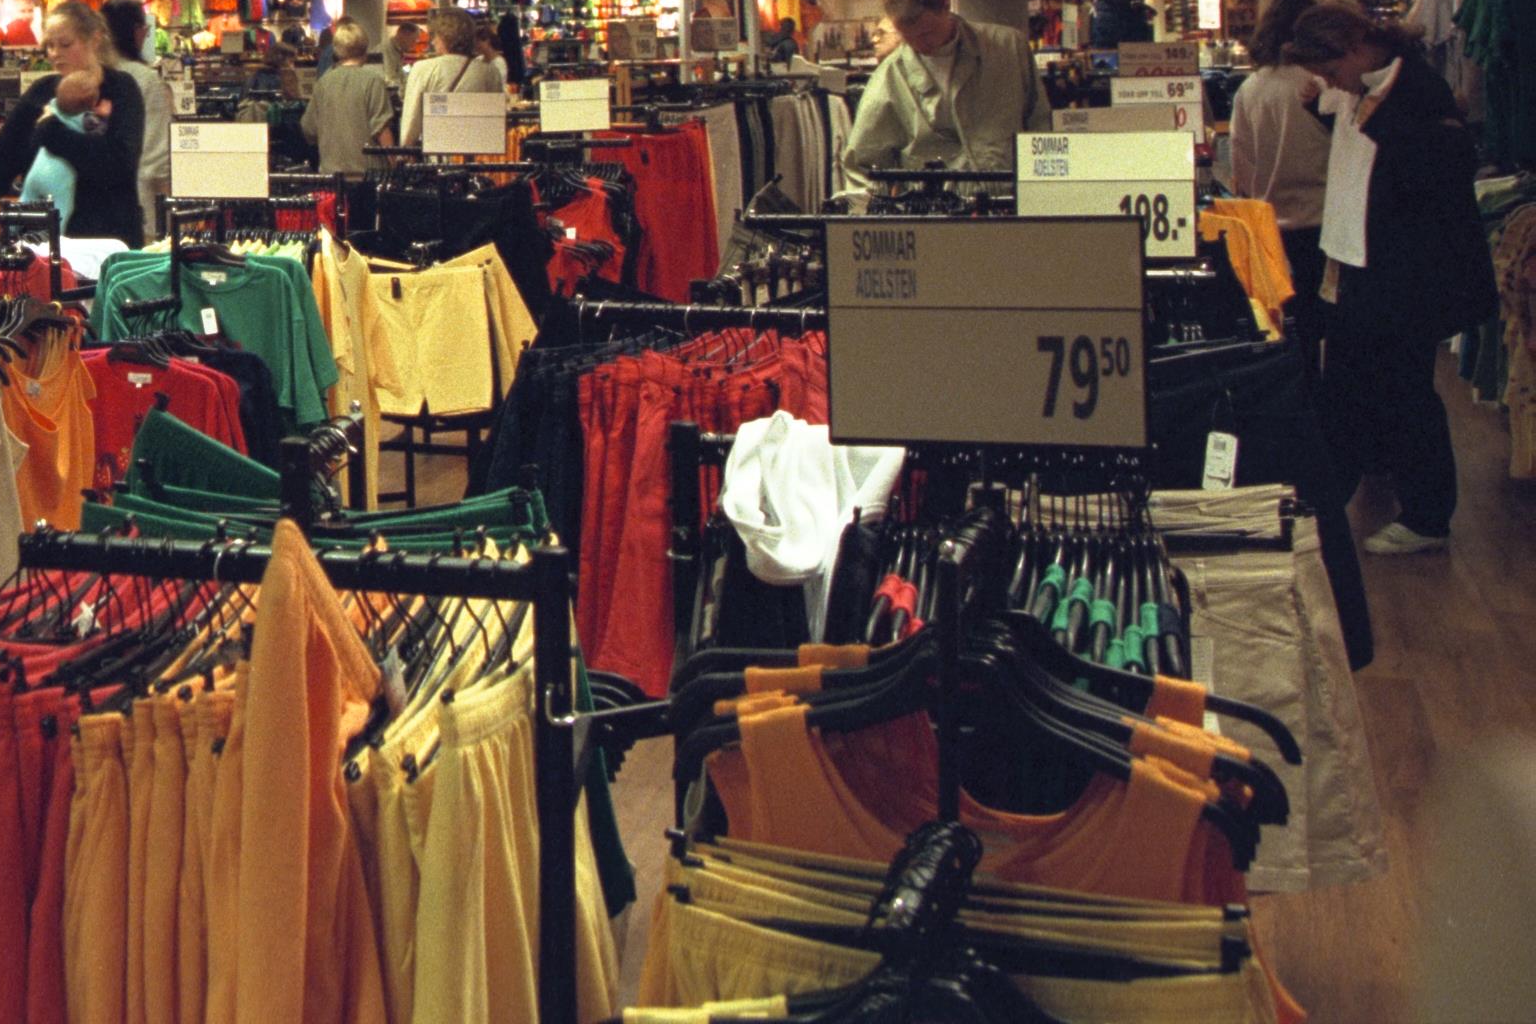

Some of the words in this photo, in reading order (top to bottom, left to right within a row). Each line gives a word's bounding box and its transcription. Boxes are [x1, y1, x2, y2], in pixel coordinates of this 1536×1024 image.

[1031, 136, 1069, 156] SOMMAR
[1033, 159, 1069, 176] ADELSTEN
[852, 229, 917, 261] SOMMAR
[855, 268, 918, 299] ADELSTEN
